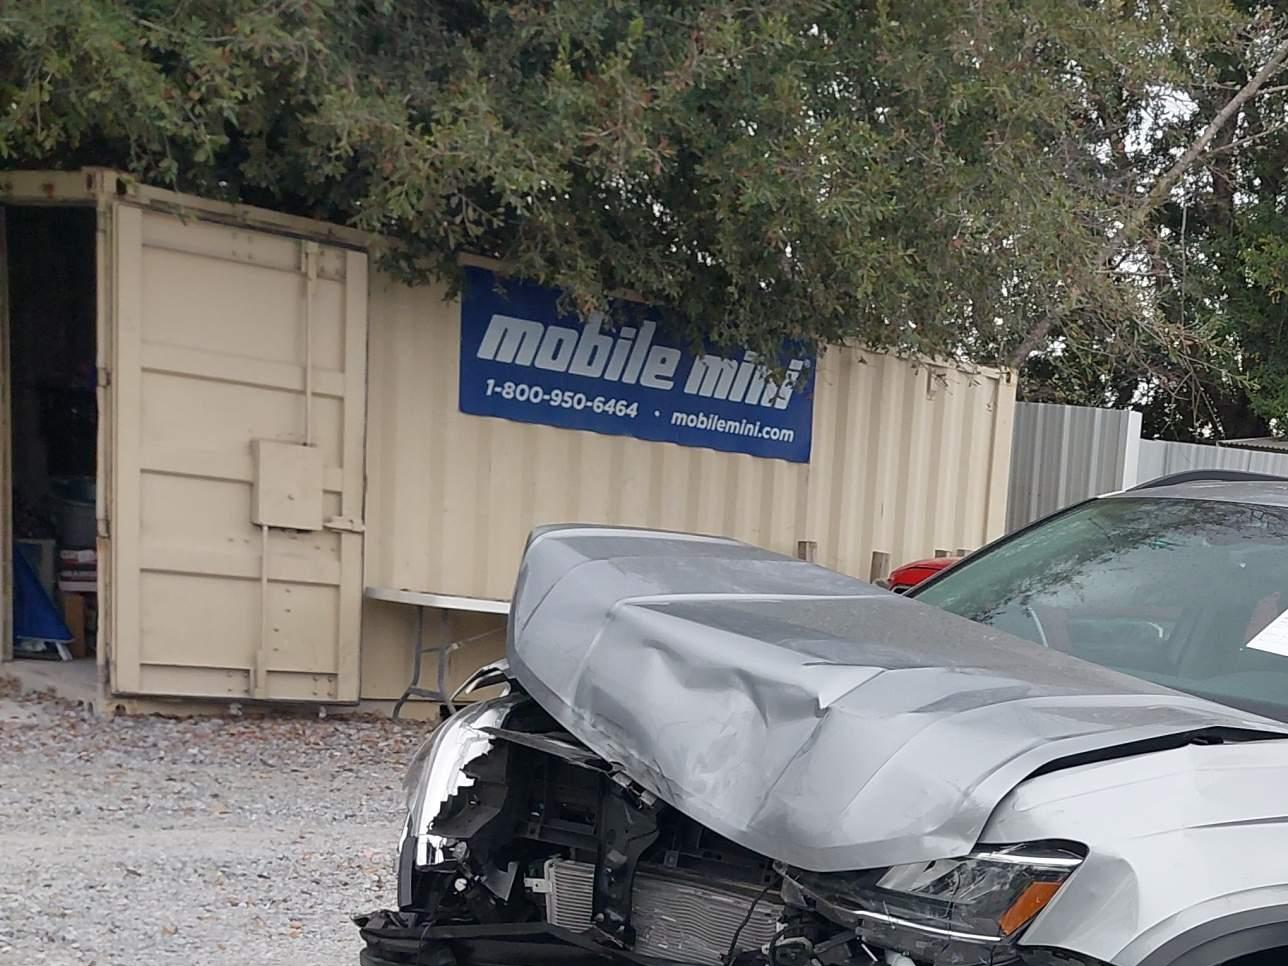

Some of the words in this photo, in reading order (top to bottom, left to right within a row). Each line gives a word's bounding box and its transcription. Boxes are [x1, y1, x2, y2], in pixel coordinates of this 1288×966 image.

[477, 312, 681, 391] mobile
[684, 350, 804, 410] mini
[485, 378, 639, 418] 1-800-950-6464
[670, 412, 795, 443] mobilemini.com
